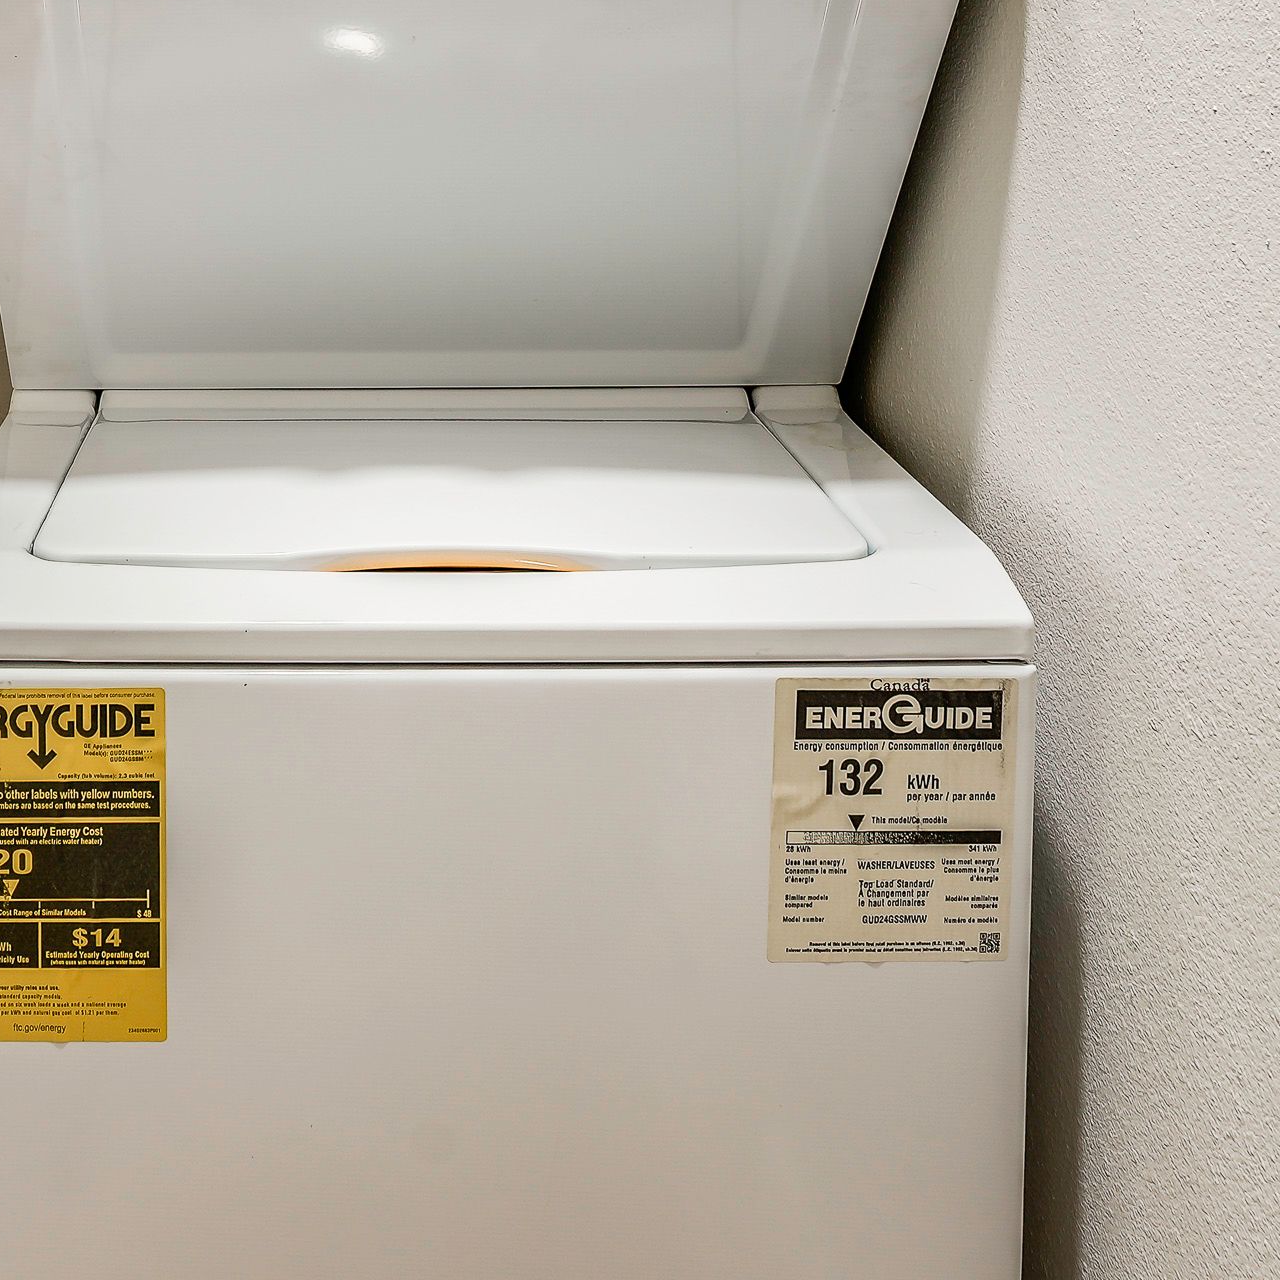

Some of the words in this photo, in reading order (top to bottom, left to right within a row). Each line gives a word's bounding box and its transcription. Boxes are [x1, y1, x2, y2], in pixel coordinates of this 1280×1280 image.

[870, 679, 930, 691] Canada
[794, 742, 822, 751] Energy
[826, 743, 878, 751] consumption
[888, 742, 949, 750] Consommation
[953, 742, 1002, 752] énergétique
[819, 759, 884, 795] 132
[907, 775, 939, 789] kWh
[5, 790, 29, 800] other
[31, 789, 57, 799] labels
[60, 789, 79, 799] with
[81, 789, 110, 800] yellow
[112, 789, 155, 799] numbers.
[907, 794, 921, 802] per
[924, 794, 943, 802] year
[952, 794, 967, 802] par
[969, 792, 996, 800] année
[21, 828, 47, 838] Yearly
[50, 828, 80, 838] Energy
[83, 827, 103, 836] Cost
[858, 861, 935, 869] WASHER/LAVEUSES
[859, 880, 873, 891] Top
[876, 880, 894, 888] Load
[897, 880, 934, 888] Standard/
[14, 909, 32, 917] Range
[73, 928, 121, 949] $14
[46, 951, 77, 959] Estimated
[79, 951, 100, 960] Yearly
[101, 951, 132, 960] Operating
[13, 1023, 66, 1033] ftc.gov/energy
